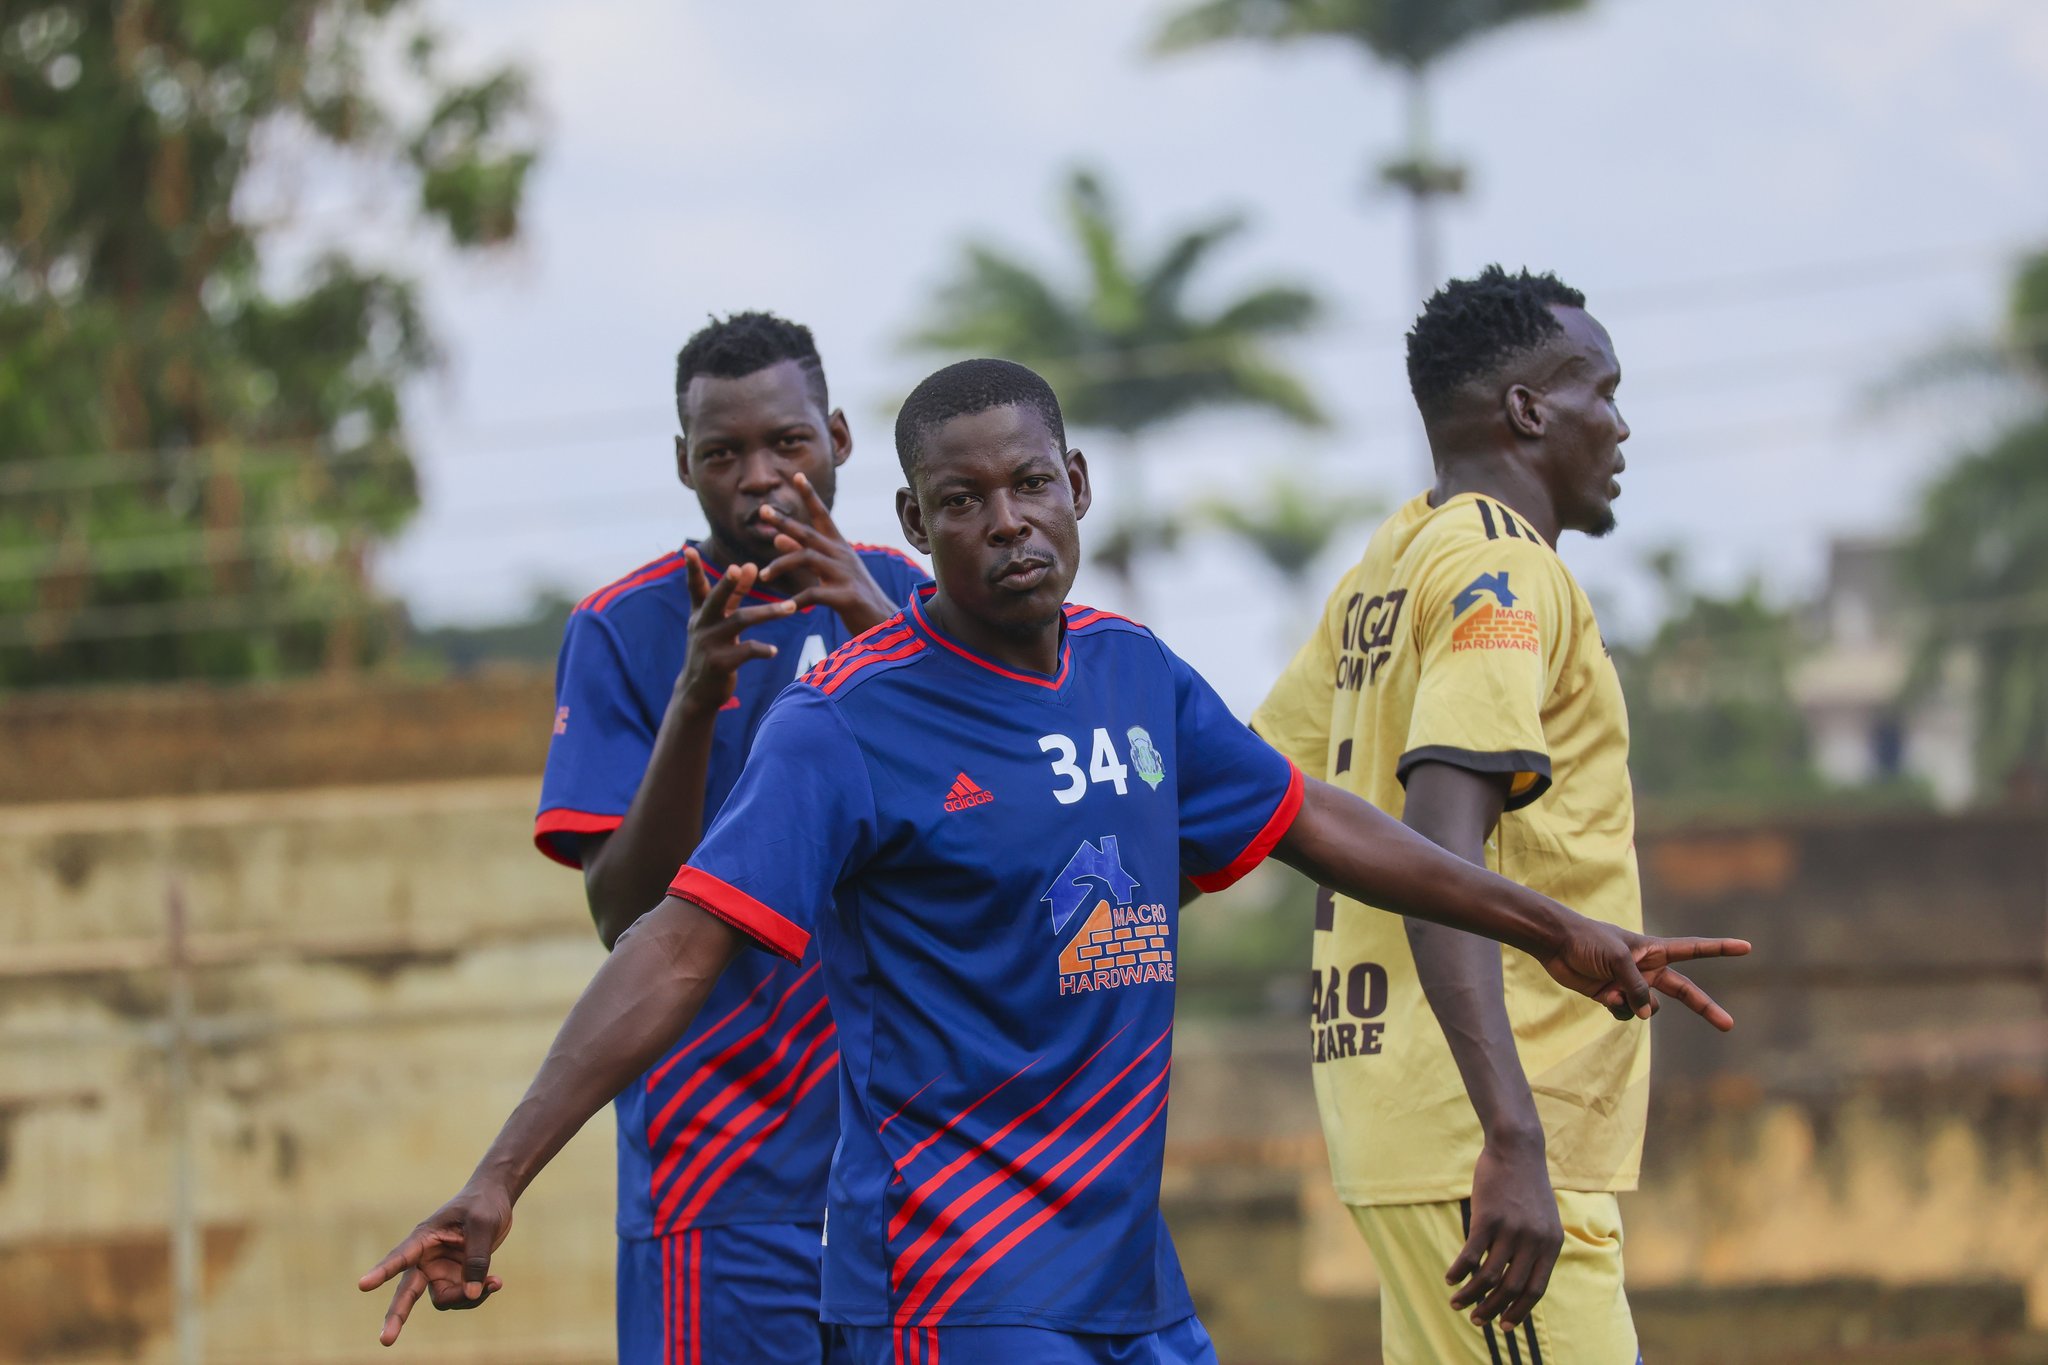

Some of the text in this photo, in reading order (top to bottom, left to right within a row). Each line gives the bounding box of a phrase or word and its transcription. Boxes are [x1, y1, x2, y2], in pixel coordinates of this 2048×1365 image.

[1452, 639, 1538, 655] HARDWARE
[1038, 728, 1128, 804] 34
[944, 789, 994, 812] adidas
[1114, 904, 1166, 927] MACRO
[1060, 963, 1174, 995] HARDWARE
